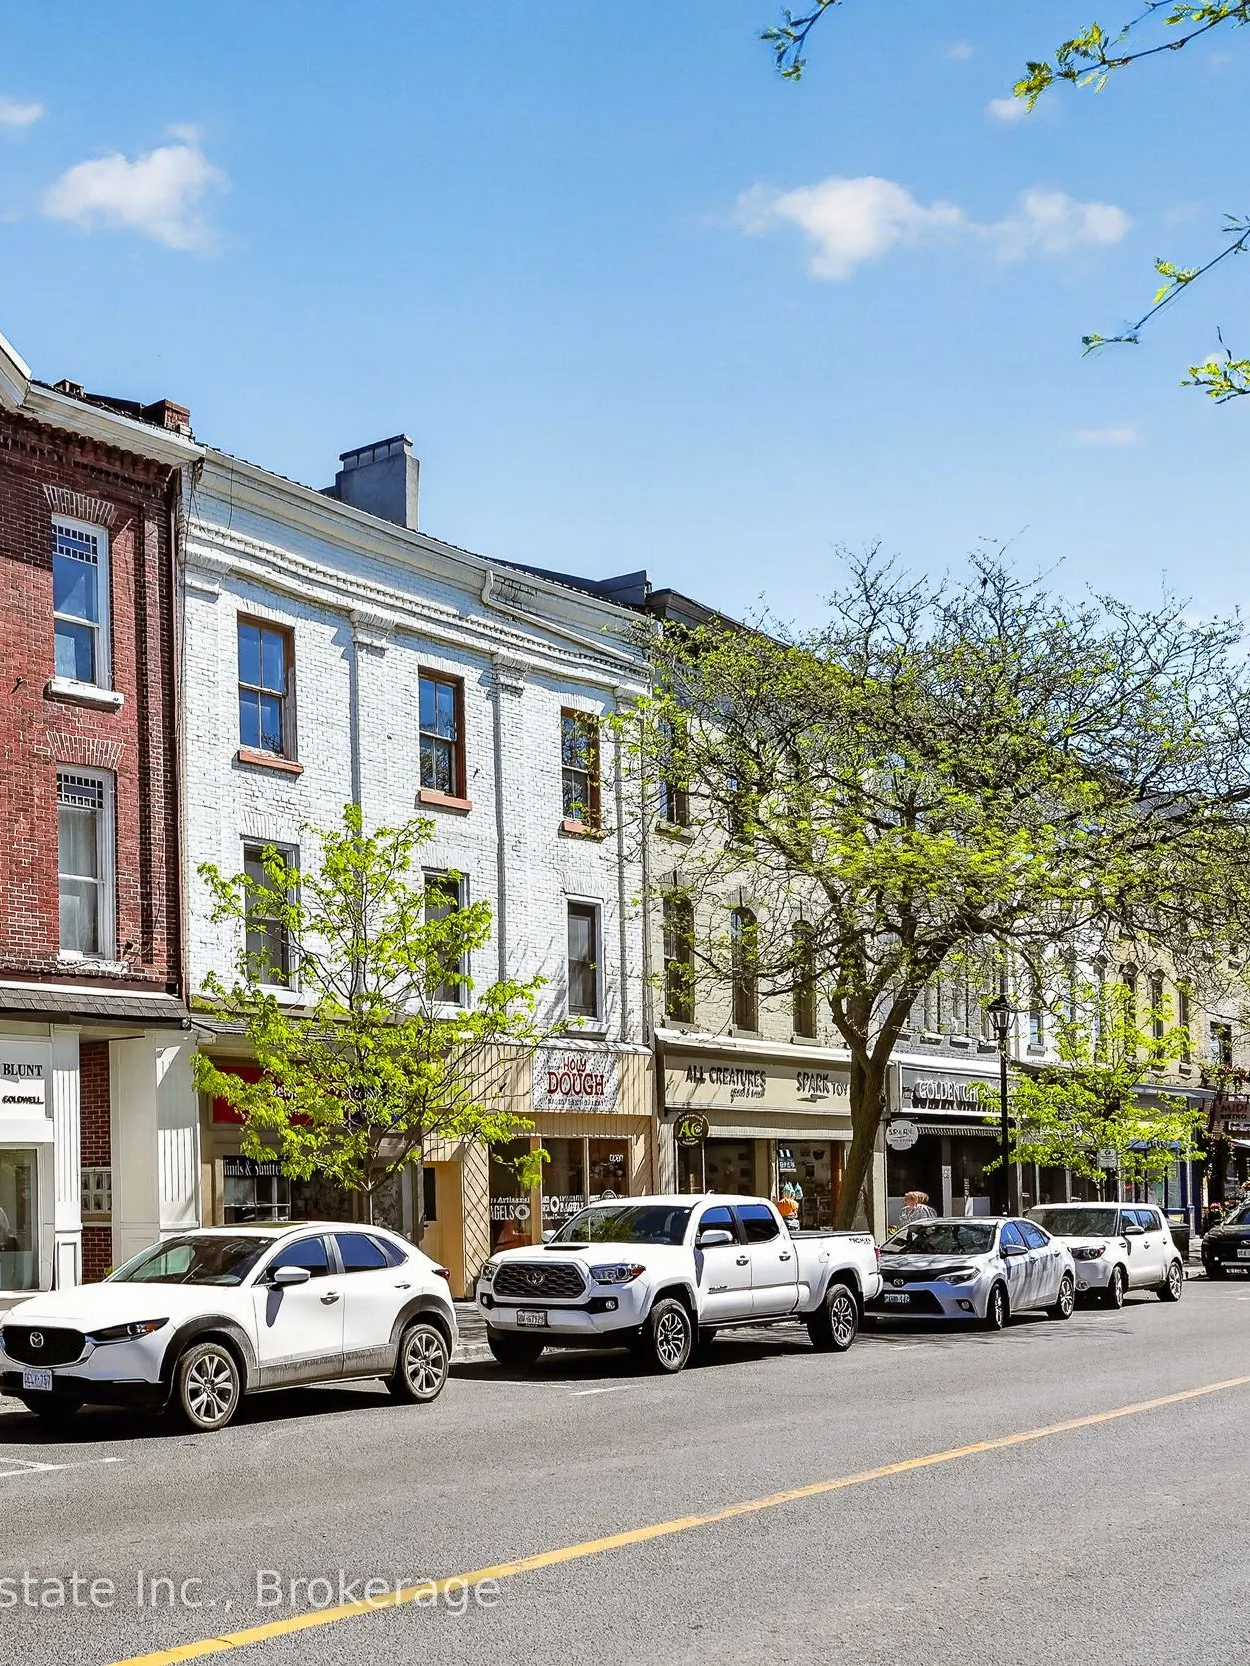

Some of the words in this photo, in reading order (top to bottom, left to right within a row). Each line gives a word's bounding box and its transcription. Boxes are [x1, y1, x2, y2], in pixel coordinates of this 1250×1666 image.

[2, 1063, 43, 1076] BLUNT
[685, 1065, 706, 1085] ALL
[709, 1067, 767, 1088] CREATURES
[547, 1072, 605, 1096] DOUGH
[796, 1071, 830, 1094] SPARK
[831, 1081, 848, 1096] TOY
